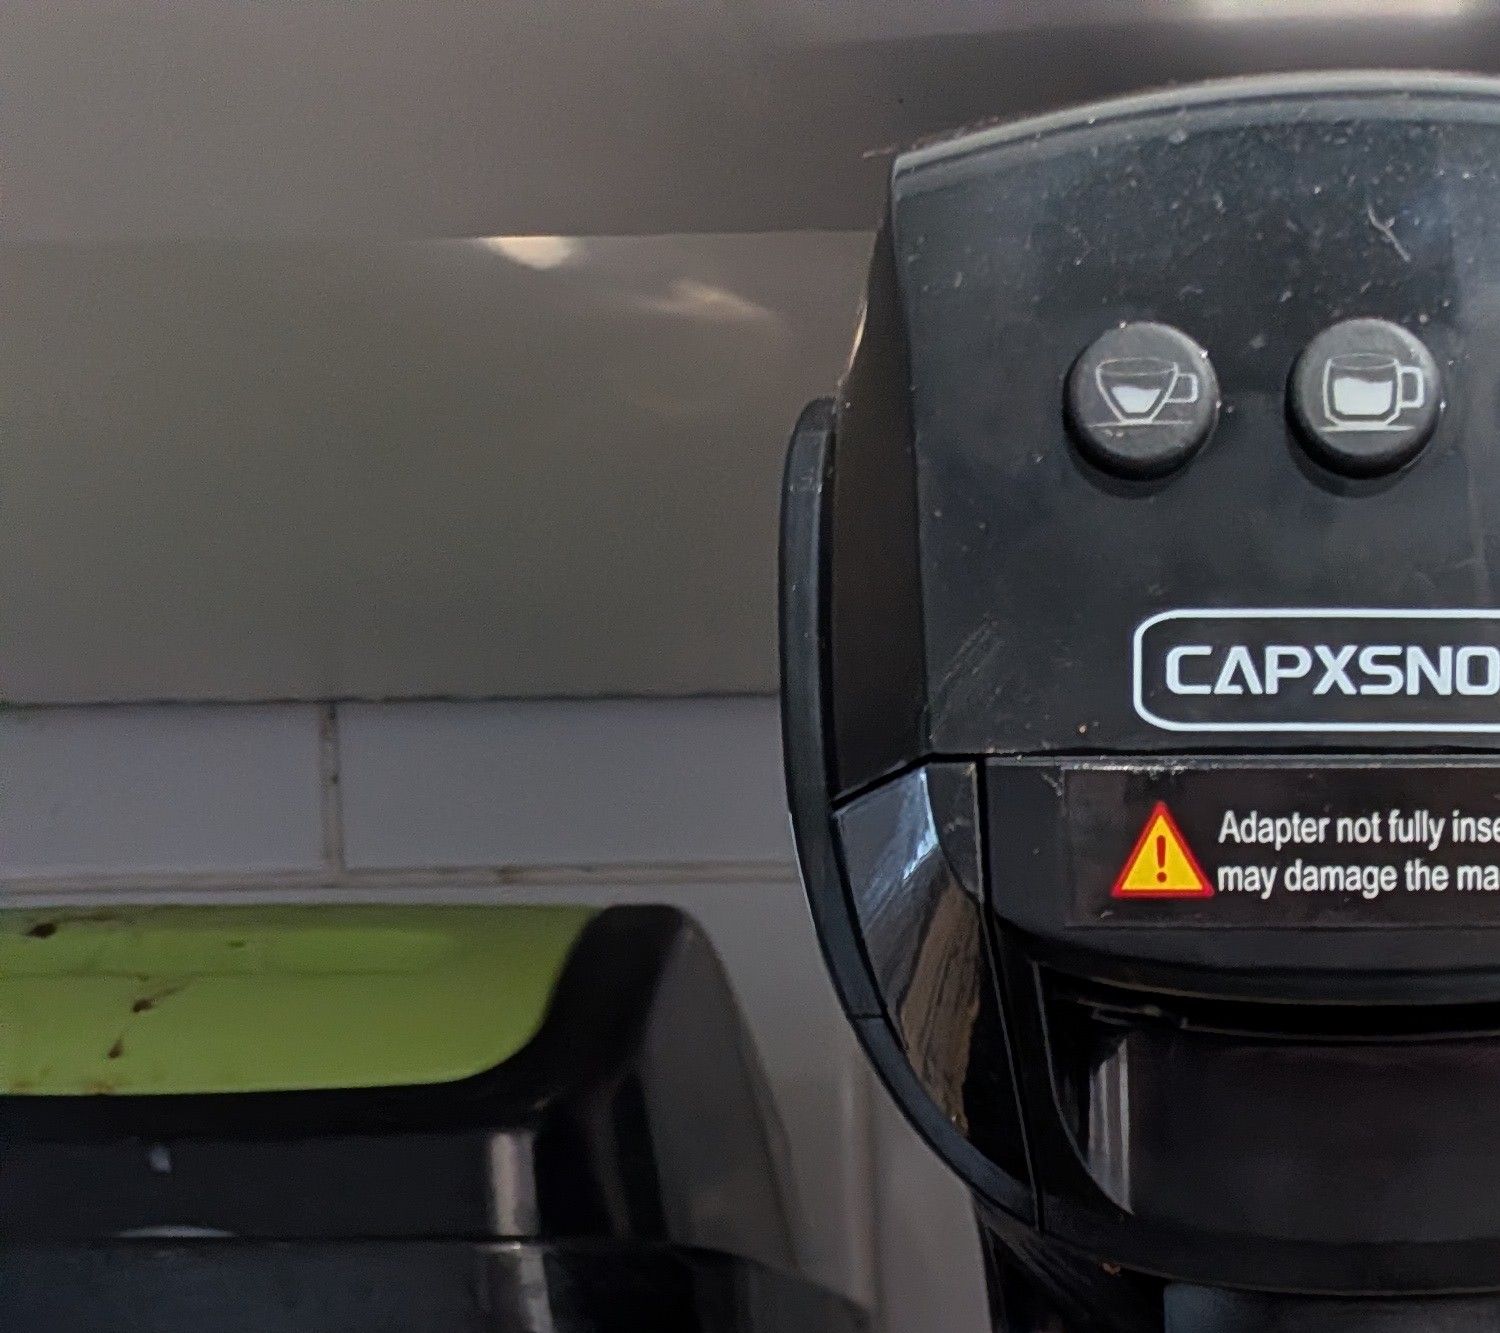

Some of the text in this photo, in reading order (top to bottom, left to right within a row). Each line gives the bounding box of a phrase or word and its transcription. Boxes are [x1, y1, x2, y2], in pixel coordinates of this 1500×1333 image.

[1218, 811, 1327, 850] Adapter
[1336, 815, 1382, 844] not
[1389, 809, 1443, 850] fully
[1217, 868, 1275, 900] may
[1284, 859, 1397, 900] damage
[1405, 859, 1449, 892] the
